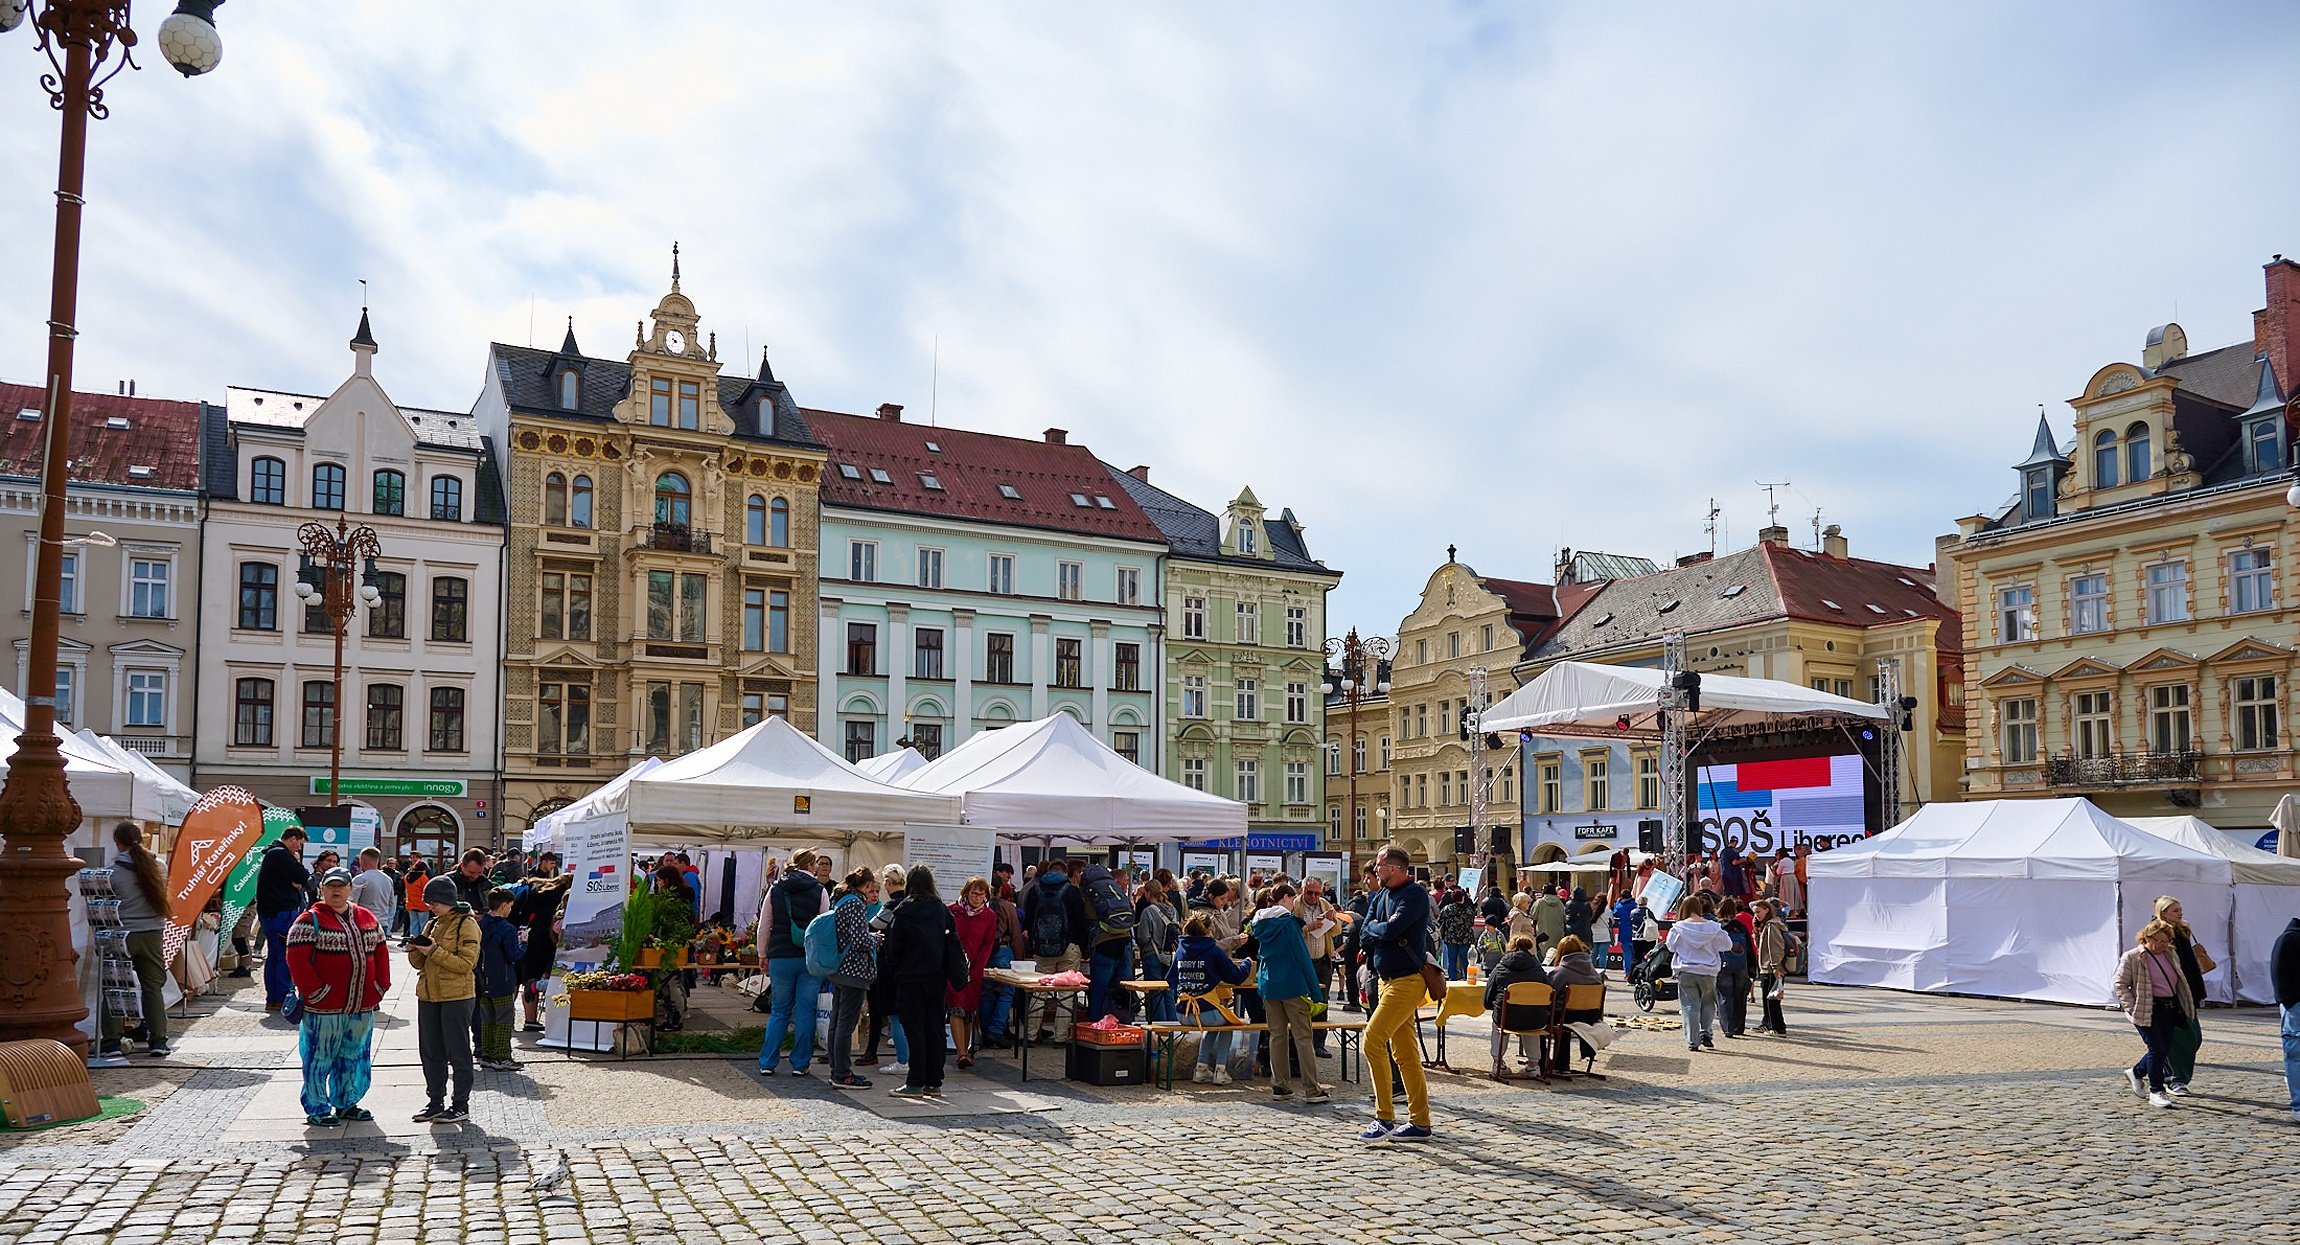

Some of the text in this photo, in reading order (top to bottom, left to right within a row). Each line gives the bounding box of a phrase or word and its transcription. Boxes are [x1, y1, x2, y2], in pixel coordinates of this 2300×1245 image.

[423, 782, 457, 794] innogy
[1596, 826, 1614, 834] KAFE
[1702, 809, 1774, 853] SOŠ
[177, 820, 248, 900] Truhlář Kateřinky!
